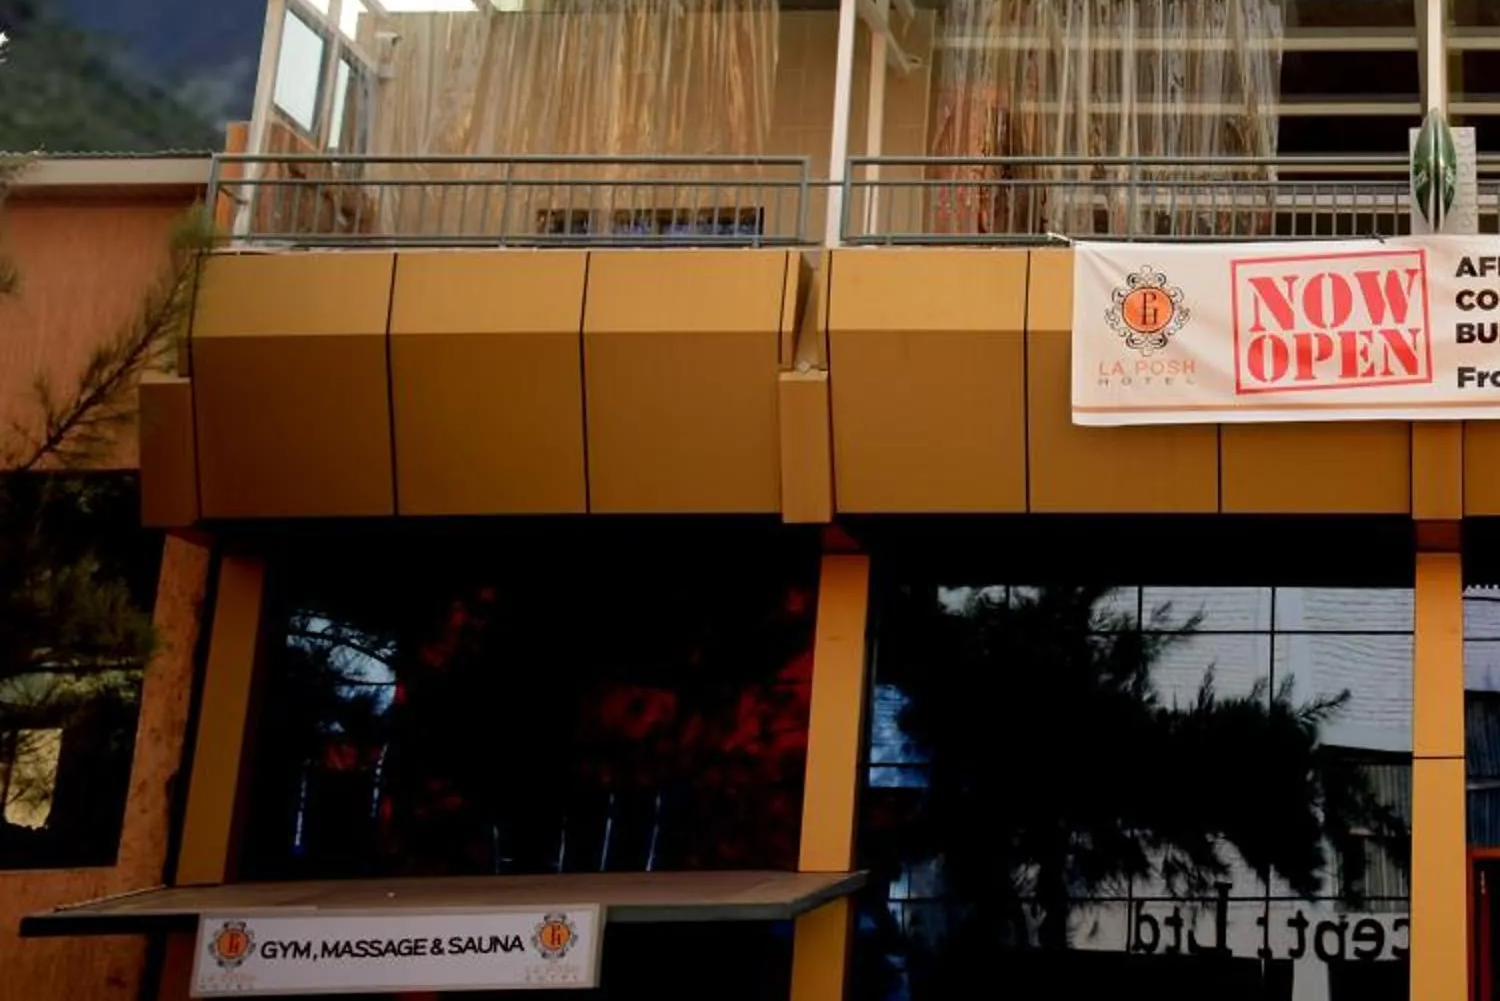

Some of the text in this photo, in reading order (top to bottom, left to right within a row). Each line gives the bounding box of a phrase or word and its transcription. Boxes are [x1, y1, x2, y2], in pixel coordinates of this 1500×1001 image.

[1248, 269, 1422, 332] NOW
[1099, 359, 1196, 376] LA POSH
[1247, 328, 1421, 383] OPEN
[1098, 377, 1197, 387] HOTEL
[261, 935, 525, 962] GYM, MASSAGE & SAUNA
